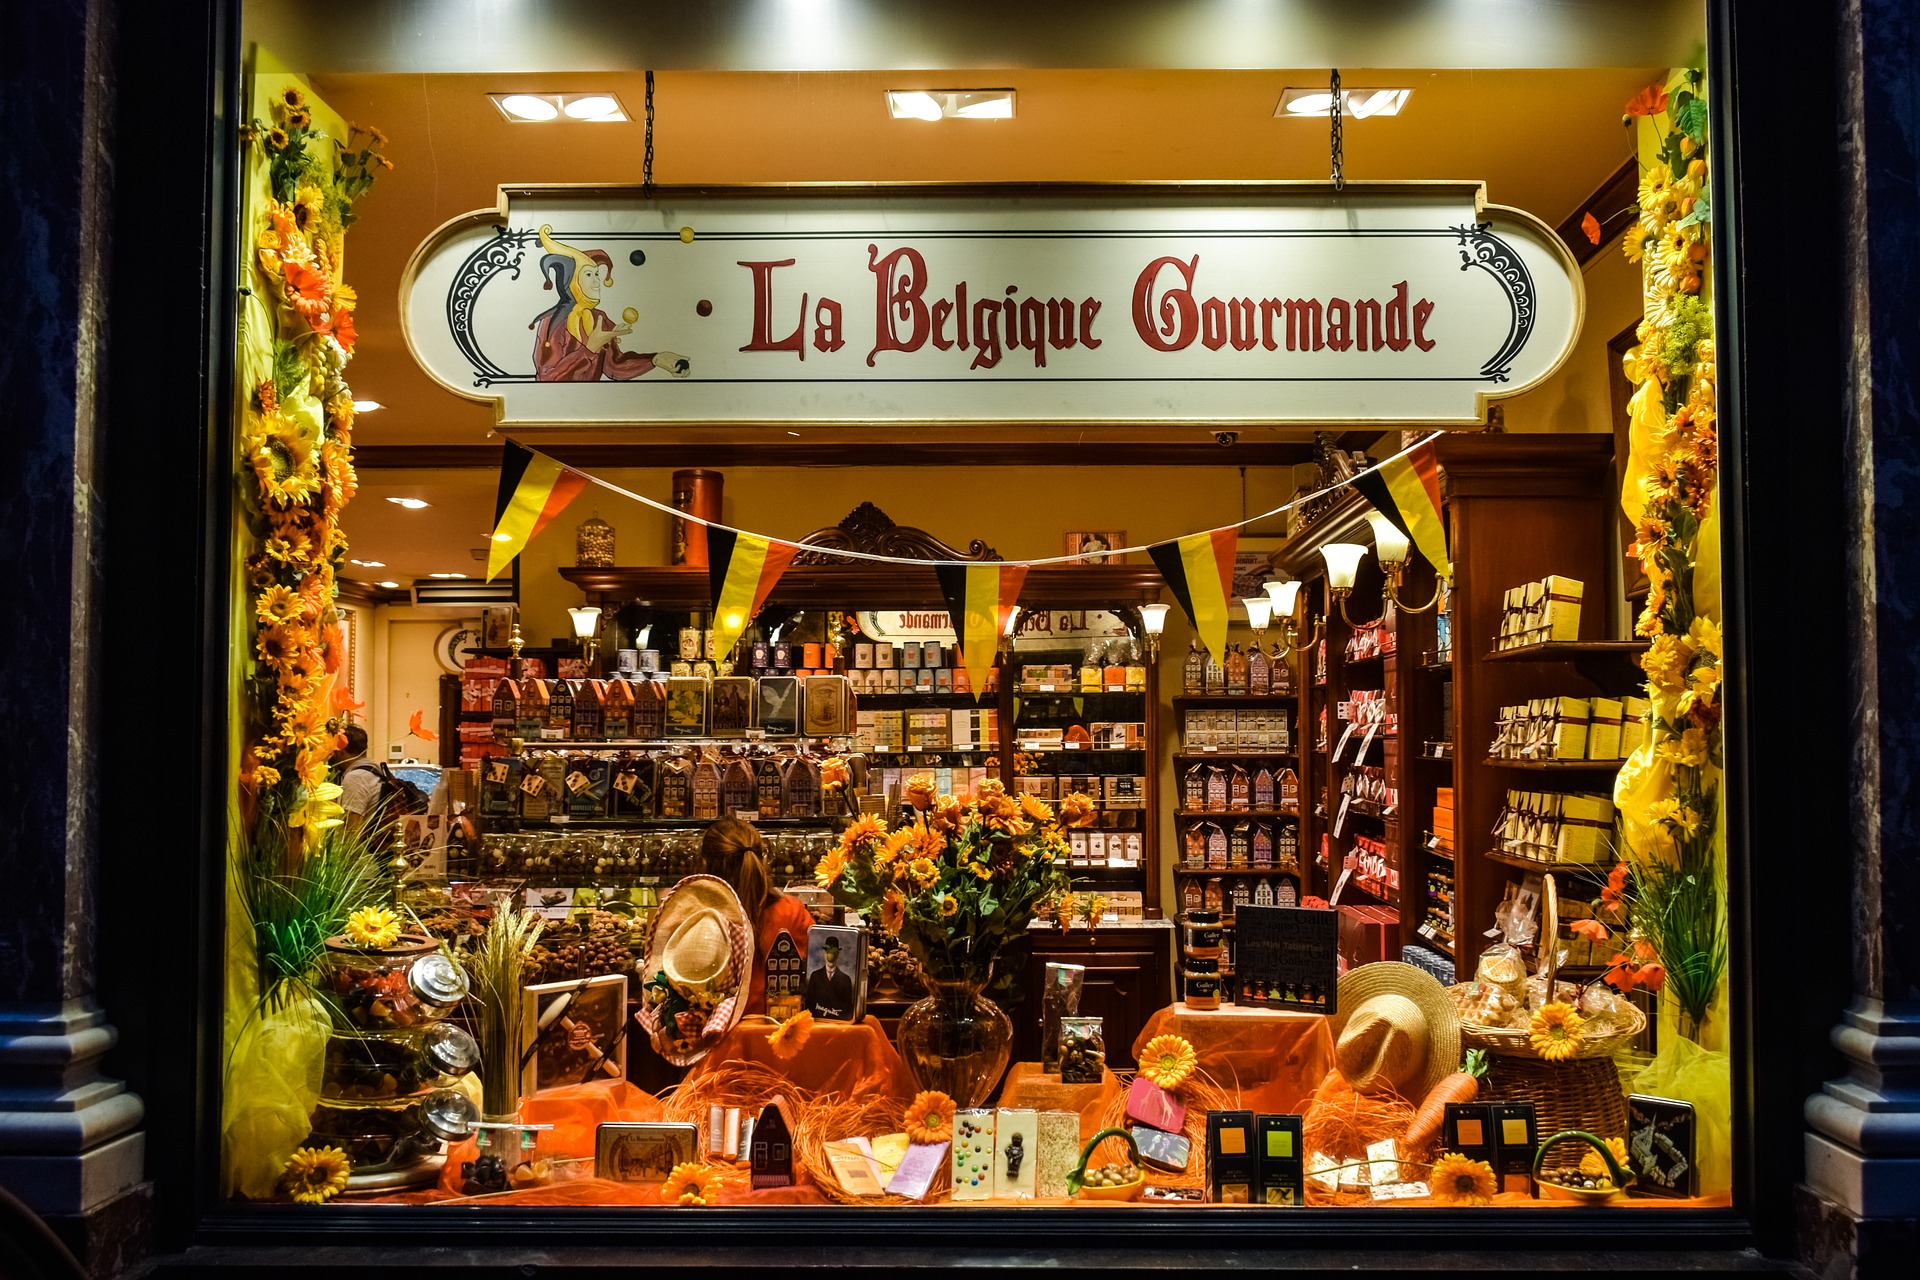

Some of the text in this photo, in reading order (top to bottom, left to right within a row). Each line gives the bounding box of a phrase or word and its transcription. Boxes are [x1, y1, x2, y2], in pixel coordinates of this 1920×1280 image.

[736, 243, 1437, 370] La Belgique Gourmande
